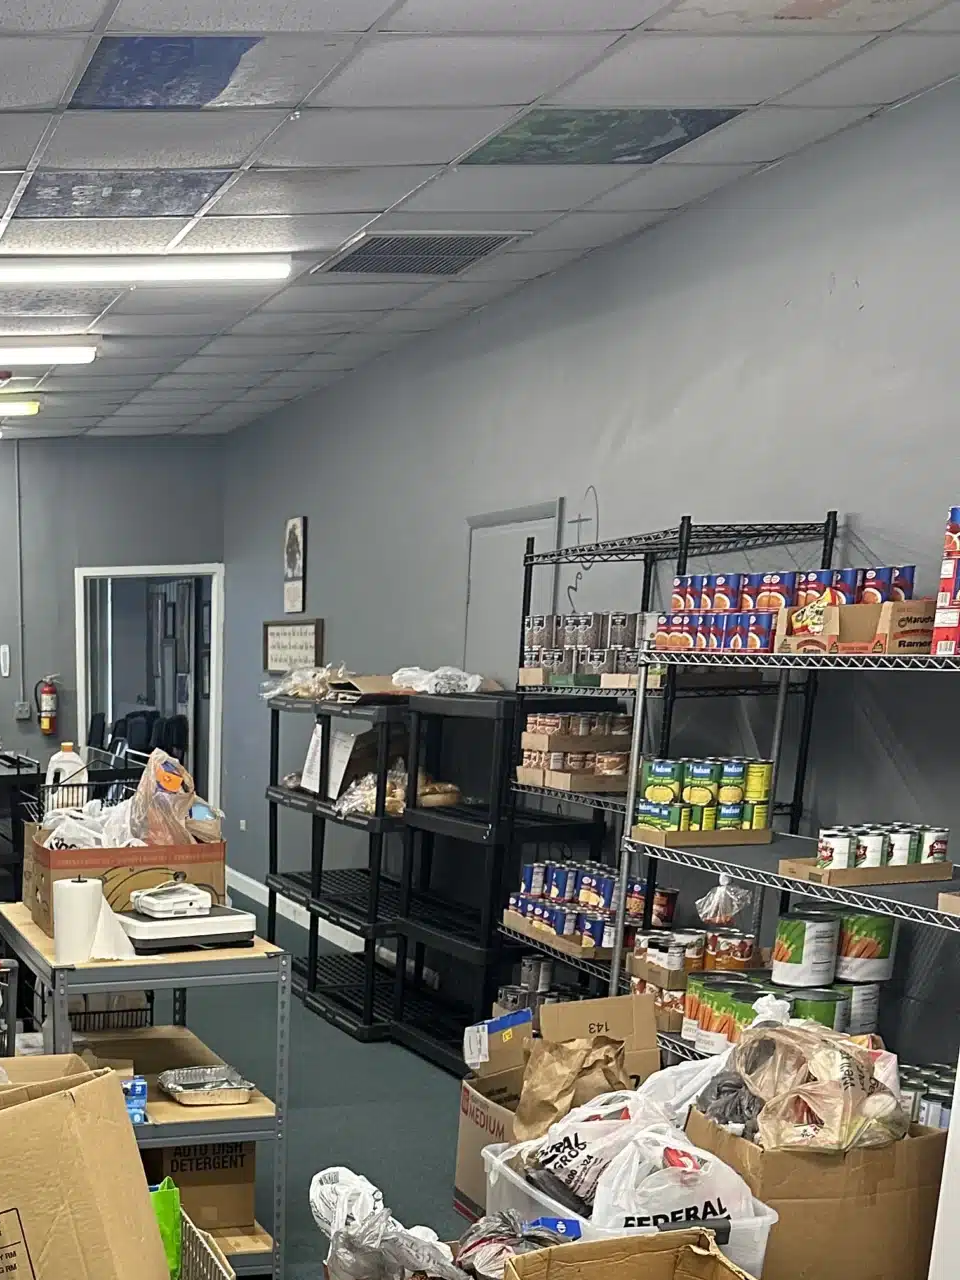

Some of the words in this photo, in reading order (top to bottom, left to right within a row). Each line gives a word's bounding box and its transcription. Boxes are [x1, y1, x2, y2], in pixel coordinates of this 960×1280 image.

[906, 615, 934, 625] Maruch
[467, 1107, 505, 1140] MEDIUM
[174, 1144, 208, 1158] AUTO
[212, 1142, 243, 1156] DISH
[170, 1154, 246, 1173] DETERGENT
[5, 1251, 17, 1259] RM
[5, 1263, 17, 1272] RM
